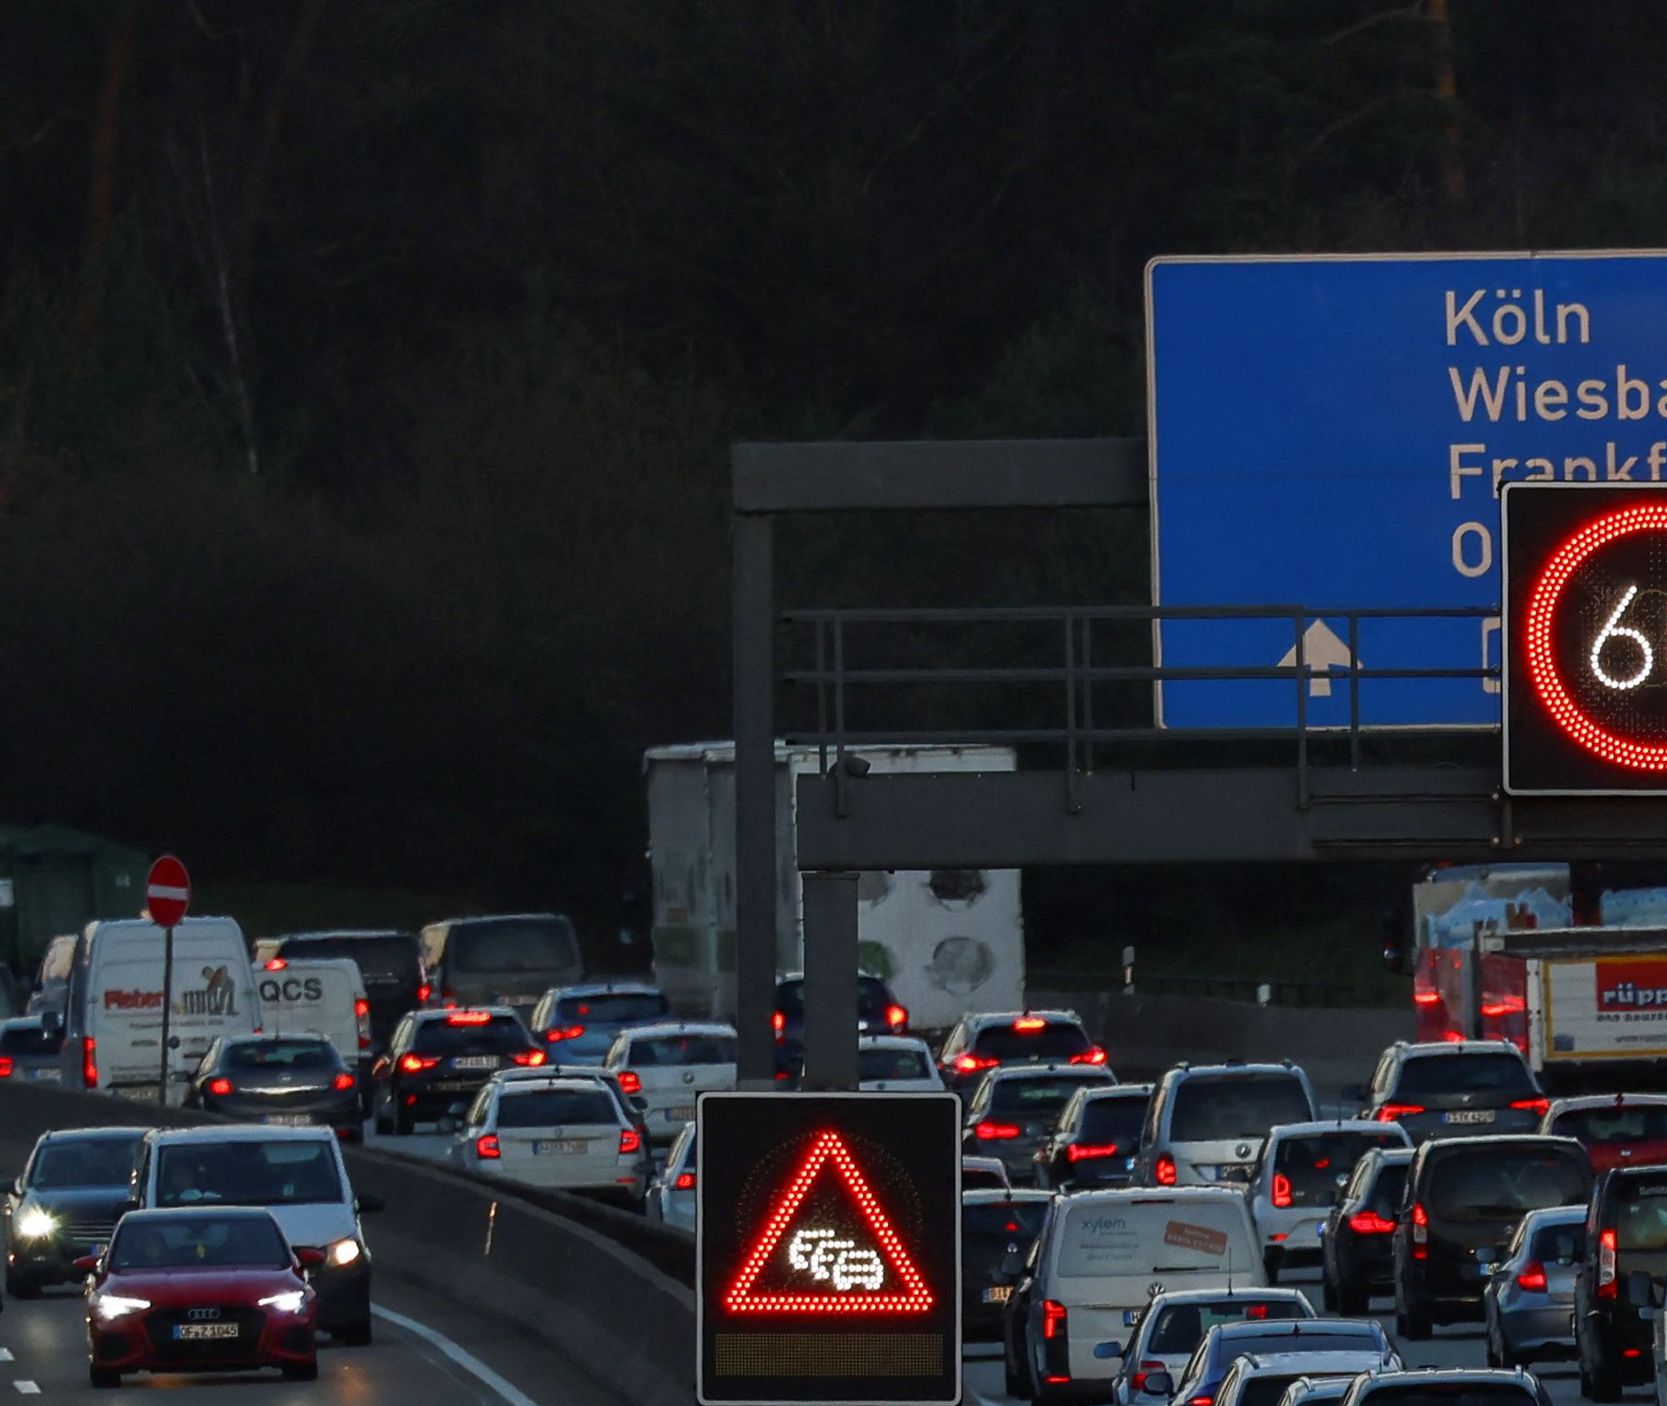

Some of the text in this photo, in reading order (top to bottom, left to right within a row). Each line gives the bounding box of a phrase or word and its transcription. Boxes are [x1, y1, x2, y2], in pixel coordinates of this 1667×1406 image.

[1444, 288, 1591, 347] Köln
[259, 977, 323, 1003] QCS
[1081, 1216, 1127, 1234] xylem
